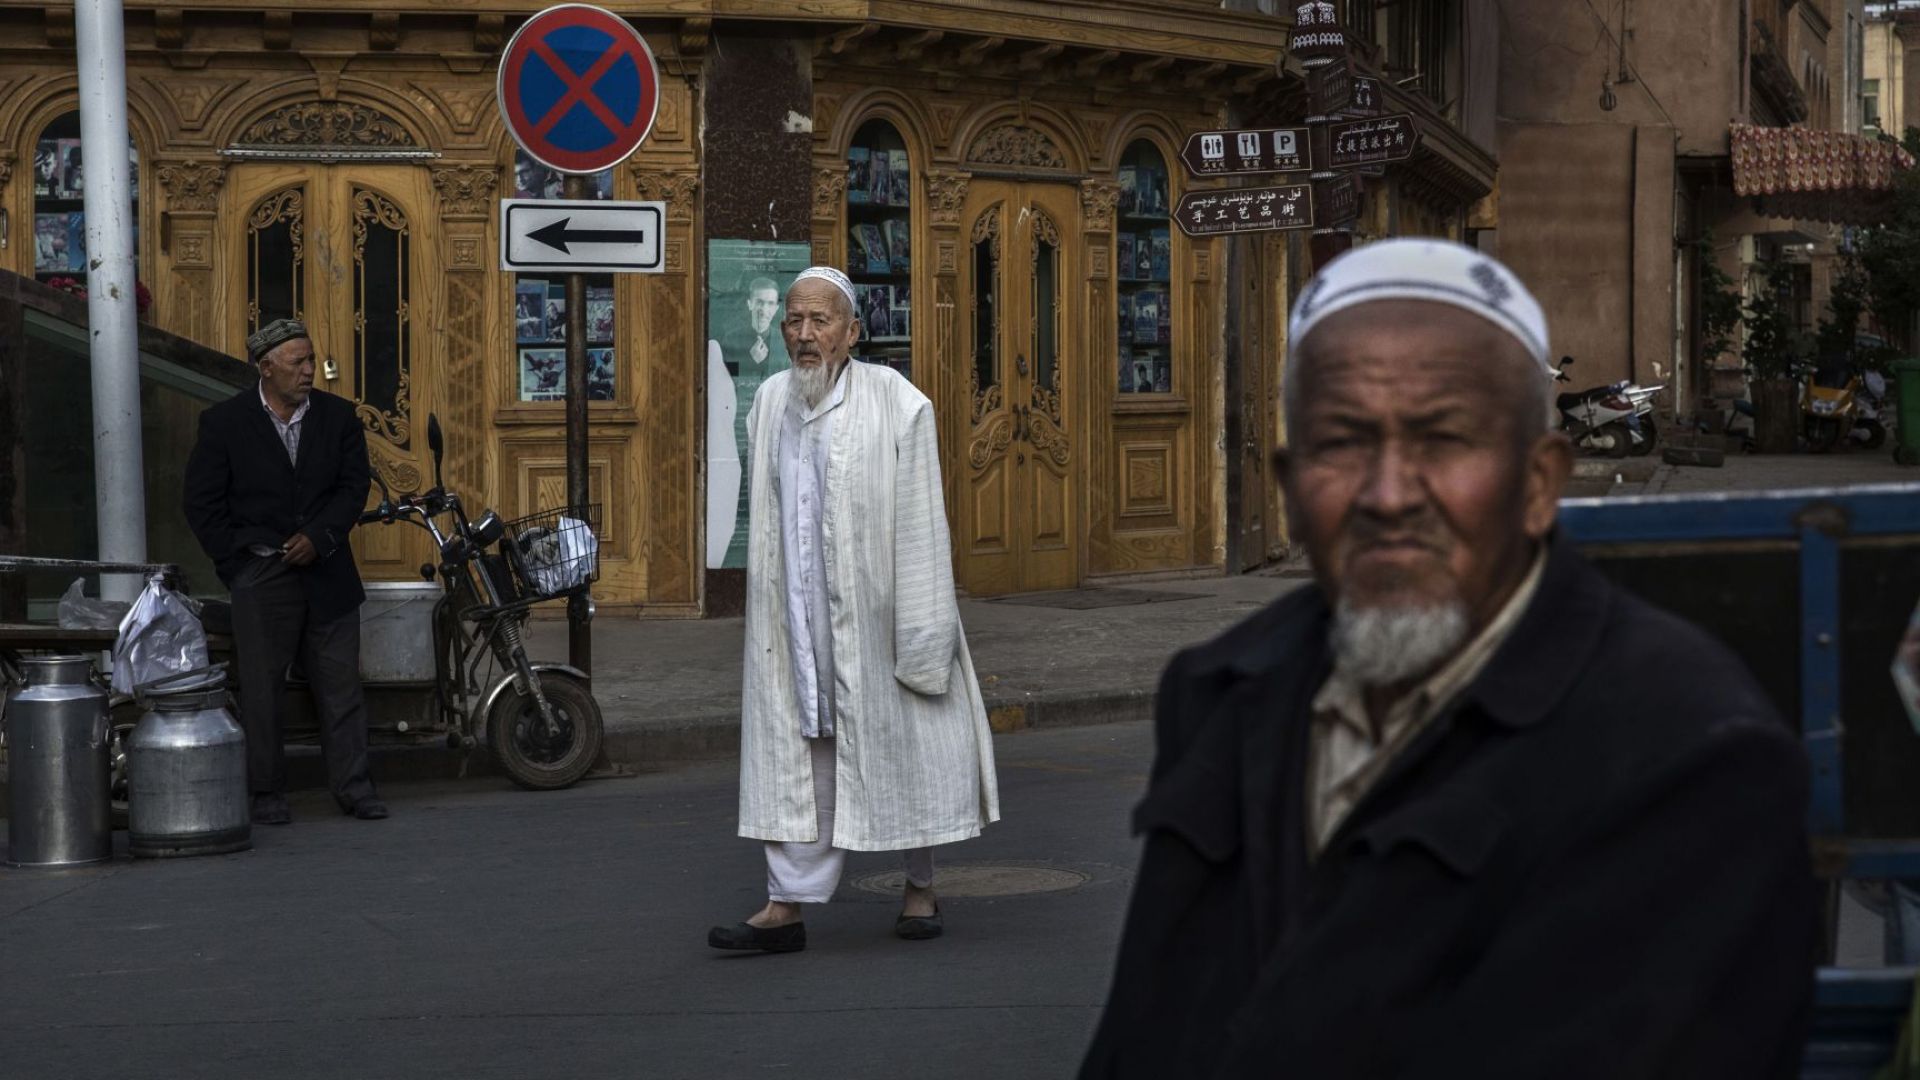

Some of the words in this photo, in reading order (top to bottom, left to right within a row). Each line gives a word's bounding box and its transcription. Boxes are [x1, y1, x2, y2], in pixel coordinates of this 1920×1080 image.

[1280, 135, 1291, 151] P
[1192, 203, 1295, 223] 手工艺品街
